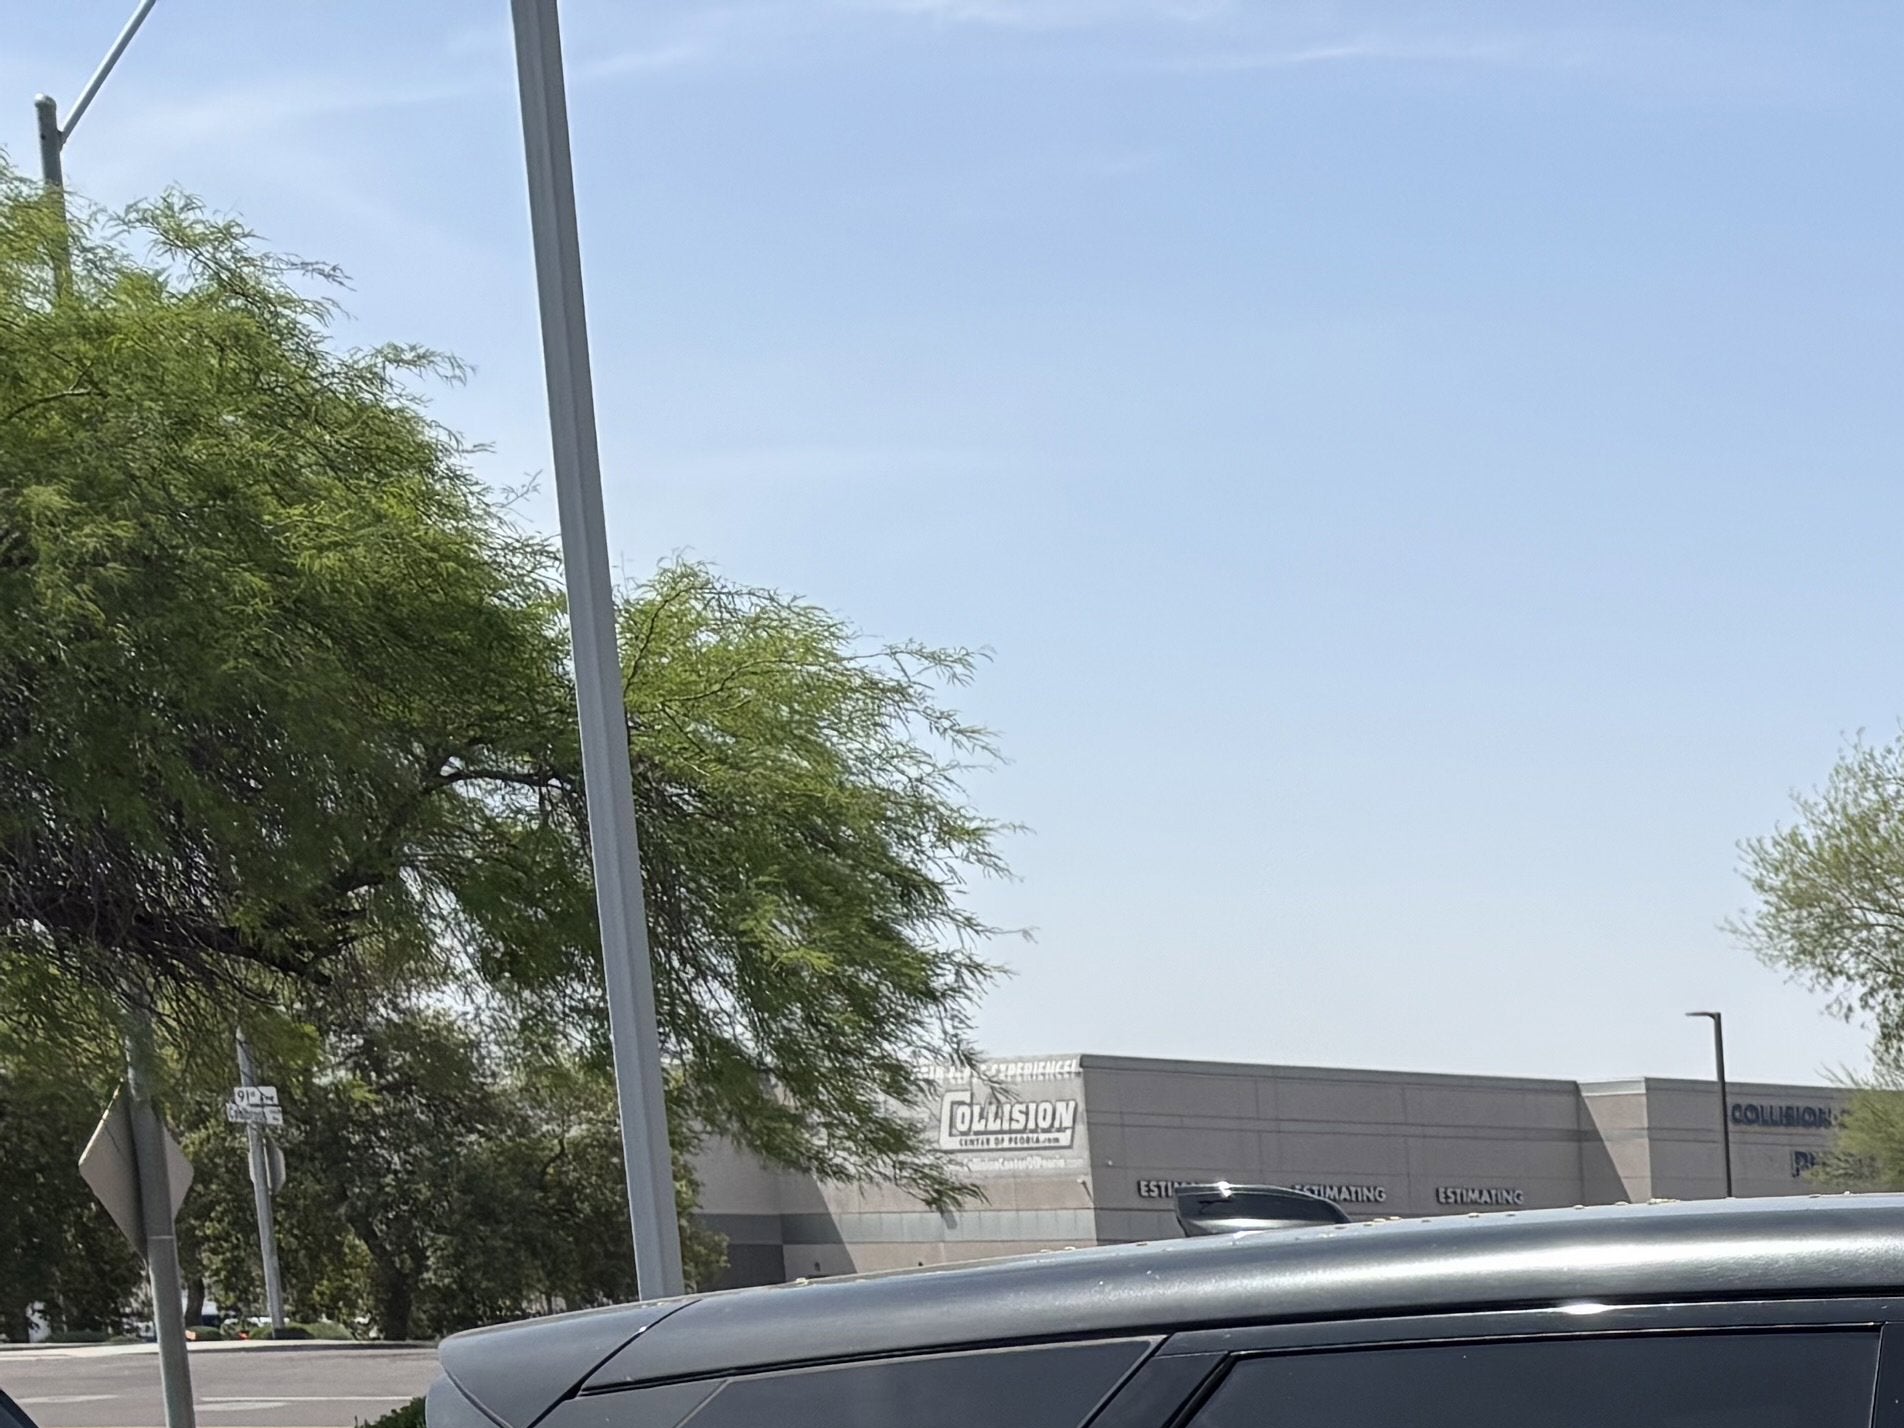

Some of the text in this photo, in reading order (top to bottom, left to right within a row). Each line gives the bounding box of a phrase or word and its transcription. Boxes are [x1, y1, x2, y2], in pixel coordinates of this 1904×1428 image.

[940, 1090, 1077, 1134] COLLISION
[1731, 1103, 1832, 1128] COLLISION
[959, 1137, 990, 1147] CENTER
[994, 1137, 1004, 1146] OF
[1436, 1187, 1524, 1205] ESTIMATING
